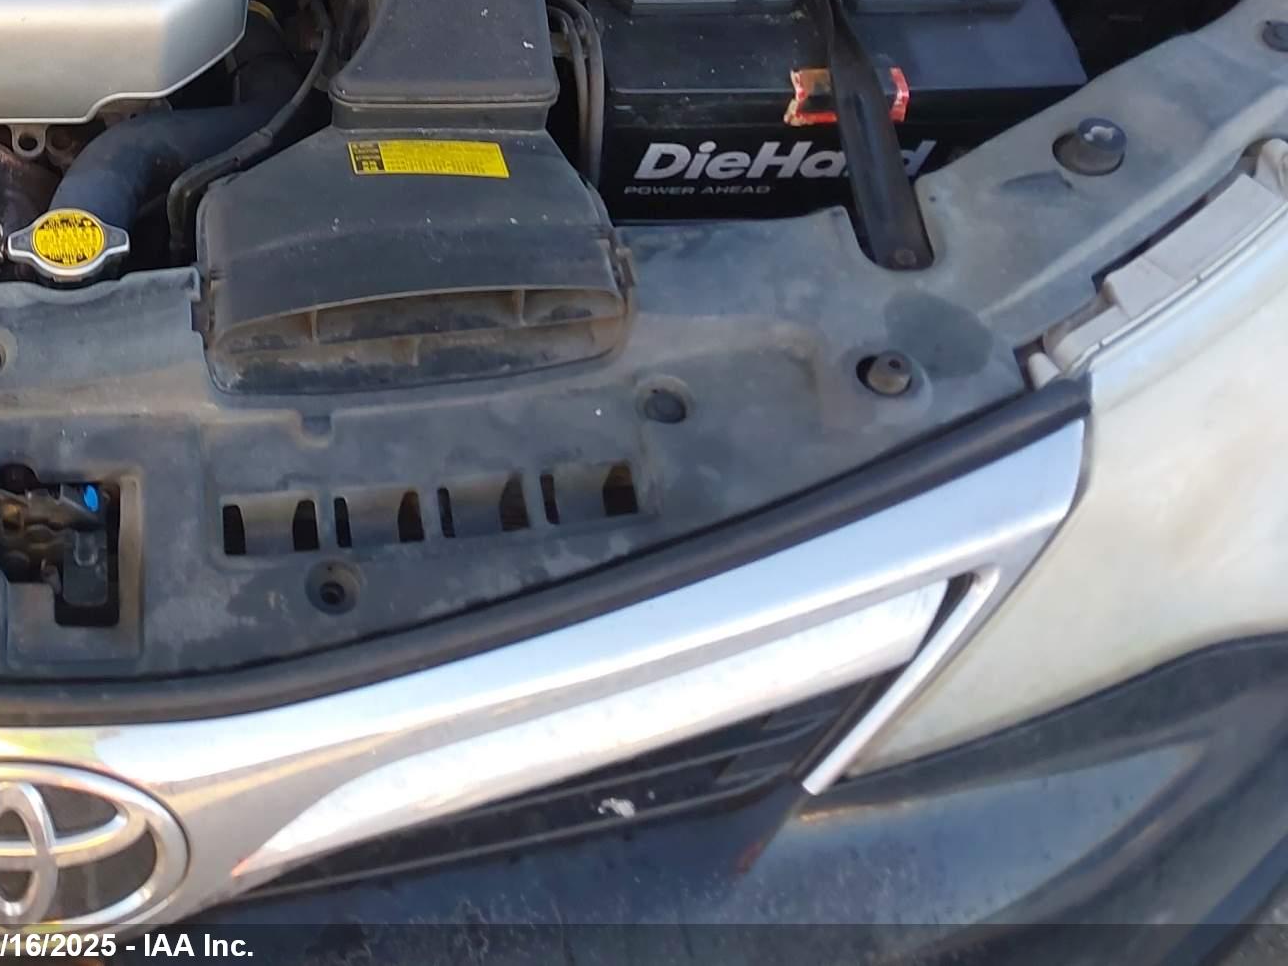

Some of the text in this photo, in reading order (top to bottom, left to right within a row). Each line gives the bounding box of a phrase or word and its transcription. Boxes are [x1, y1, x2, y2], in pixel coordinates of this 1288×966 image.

[633, 140, 937, 180] DieHad
[623, 185, 771, 195] POWER AHEAD
